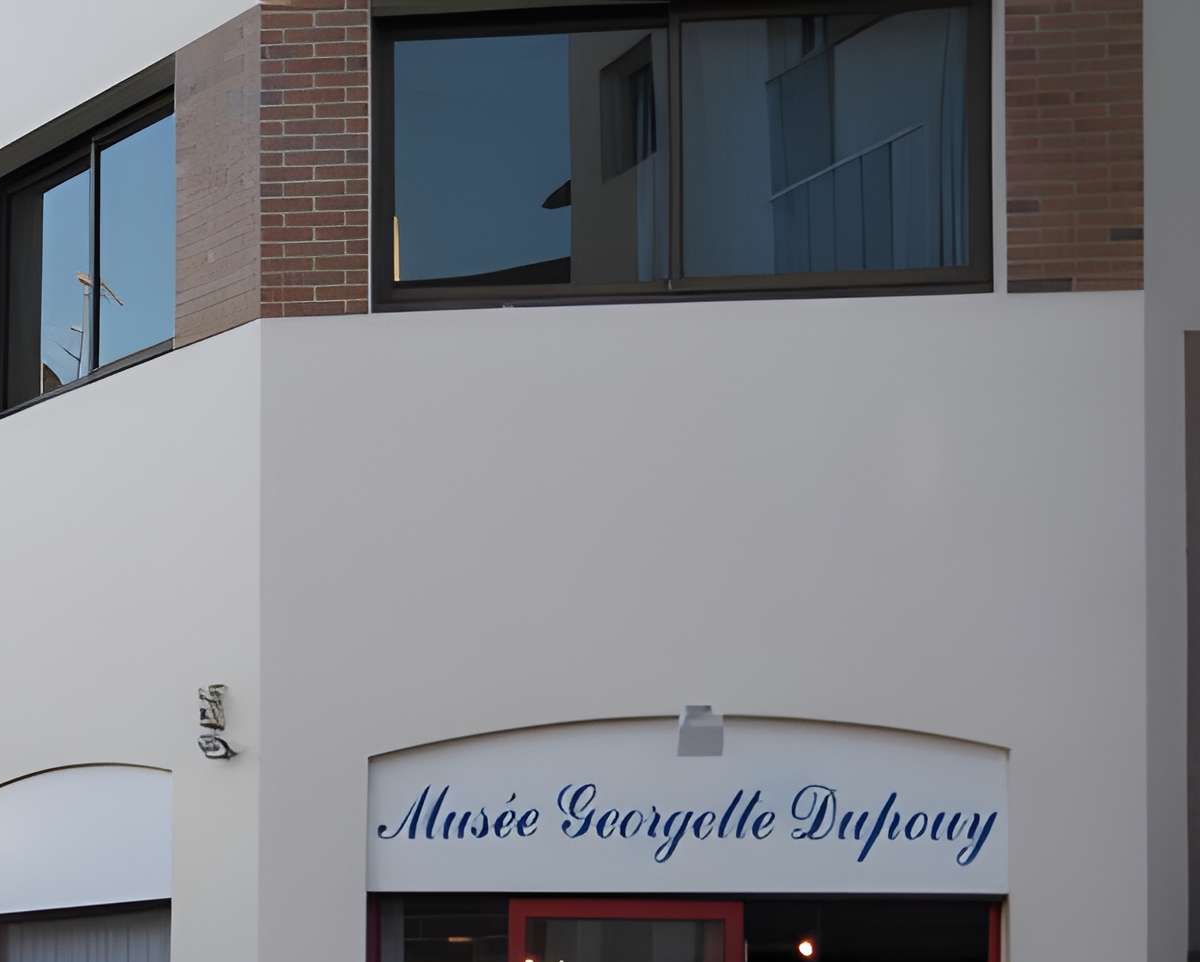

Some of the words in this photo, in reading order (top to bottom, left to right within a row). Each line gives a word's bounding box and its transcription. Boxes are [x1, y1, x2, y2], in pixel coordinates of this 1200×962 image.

[377, 784, 539, 840] Musée
[556, 783, 776, 864] Georgette
[790, 784, 999, 867] Dupouy
